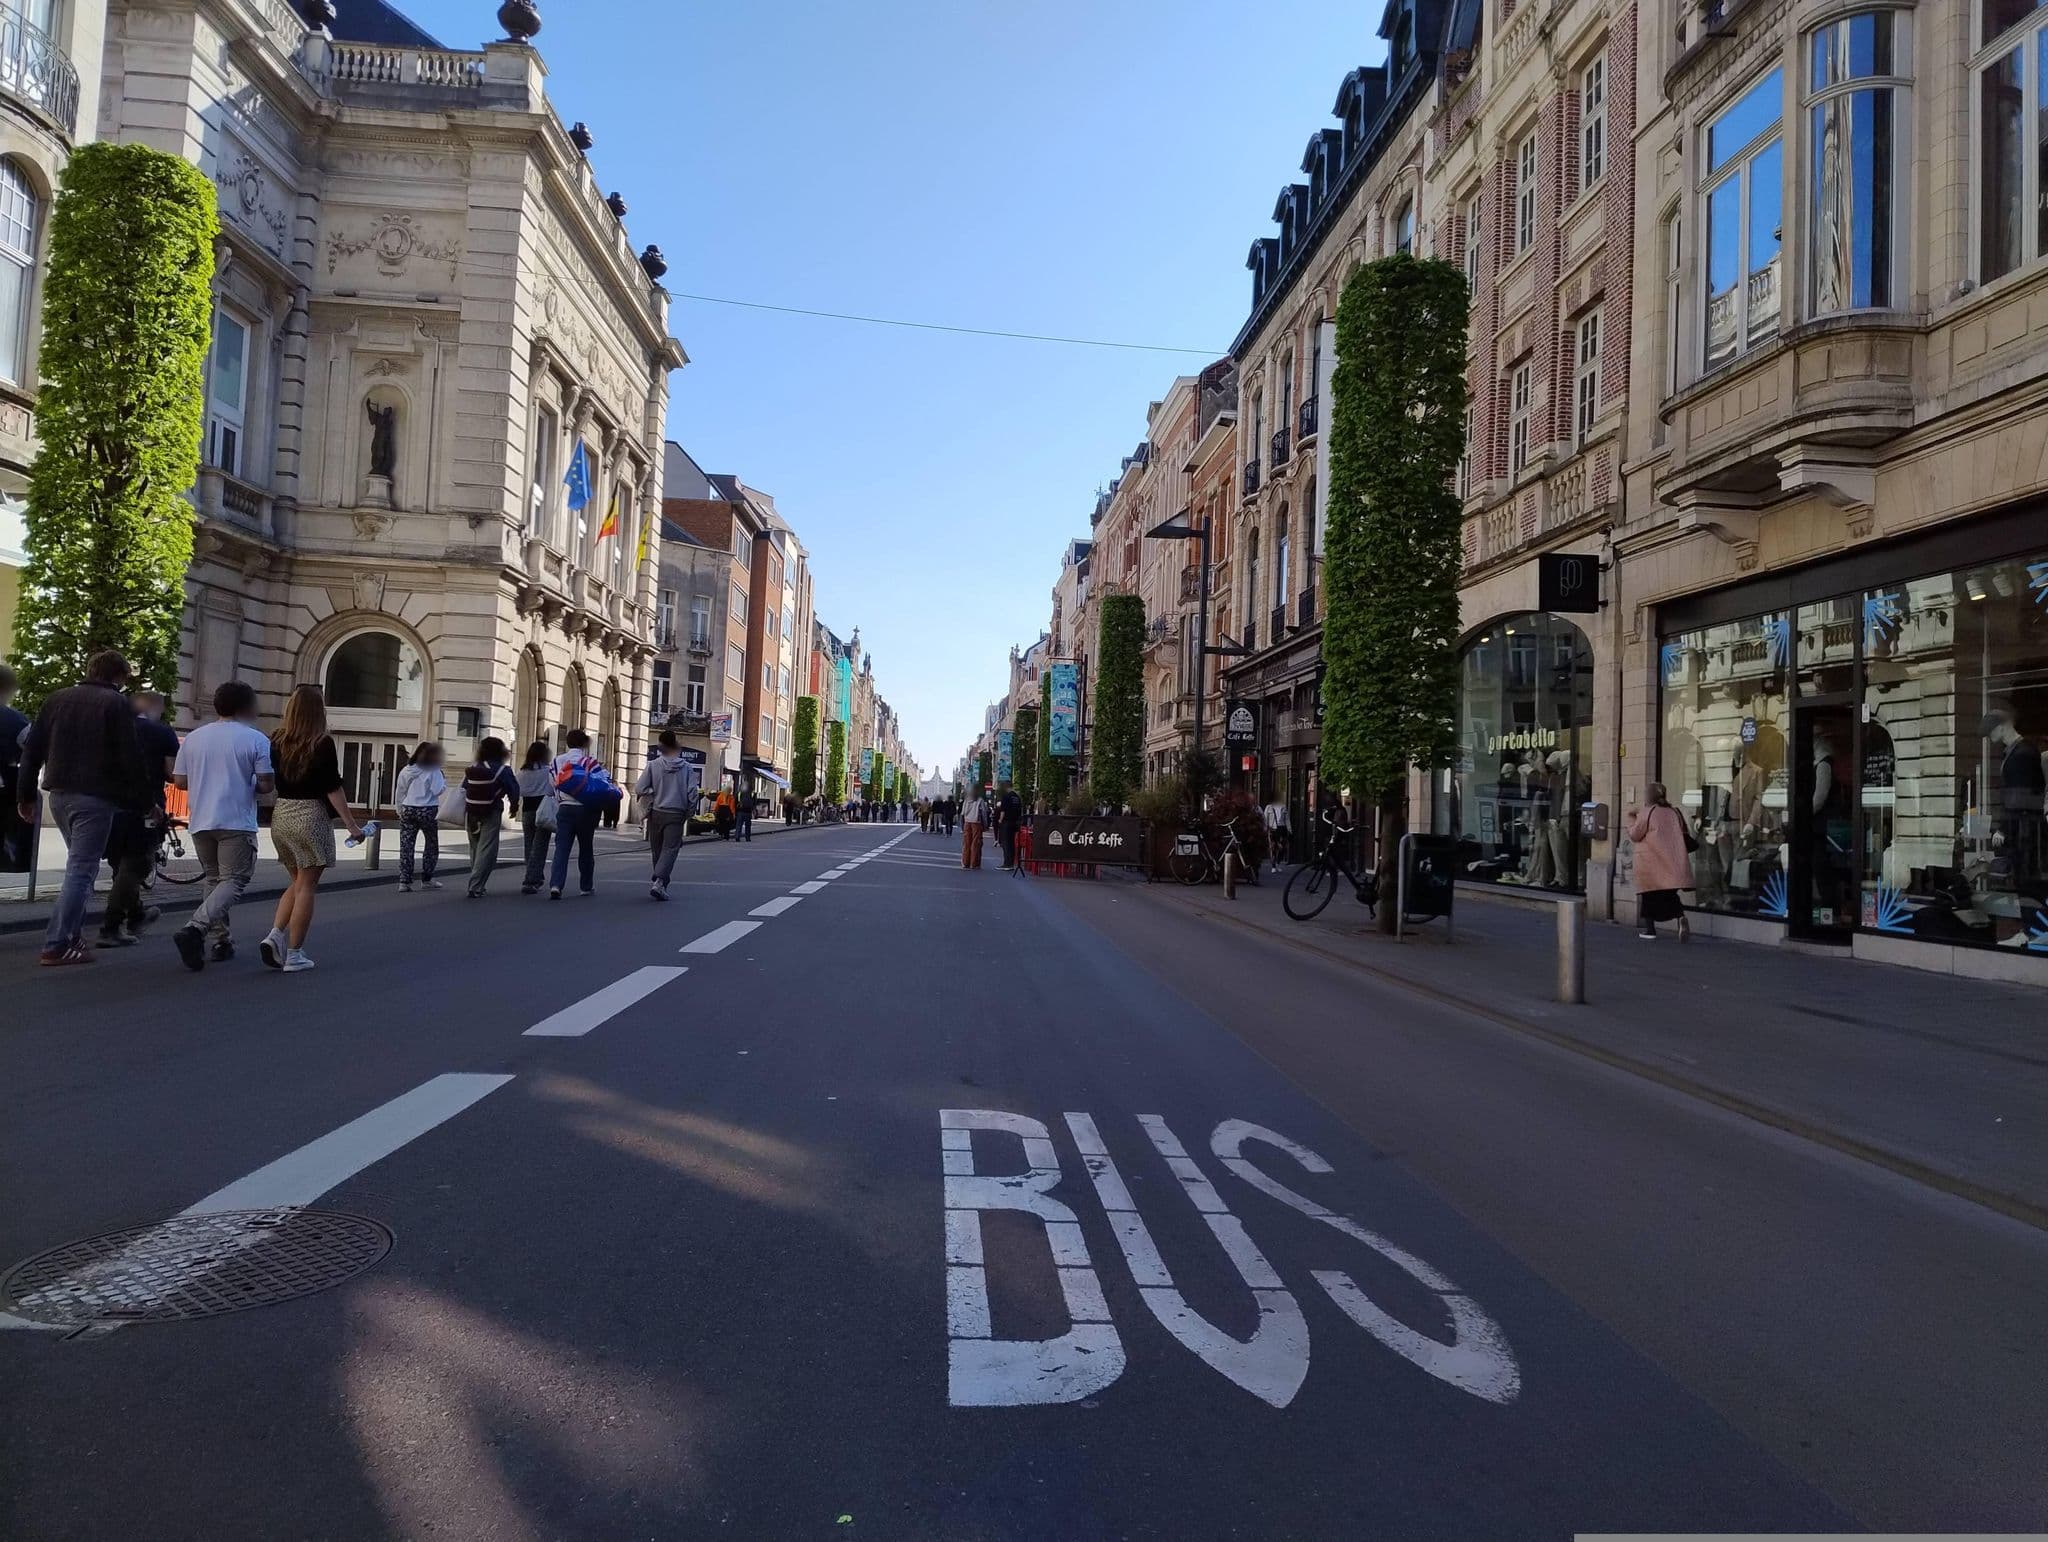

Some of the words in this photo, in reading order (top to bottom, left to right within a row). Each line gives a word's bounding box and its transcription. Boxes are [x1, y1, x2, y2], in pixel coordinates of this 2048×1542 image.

[1068, 831, 1094, 847] Café
[1097, 831, 1123, 848] Leffe
[938, 1108, 1522, 1410] BUS
